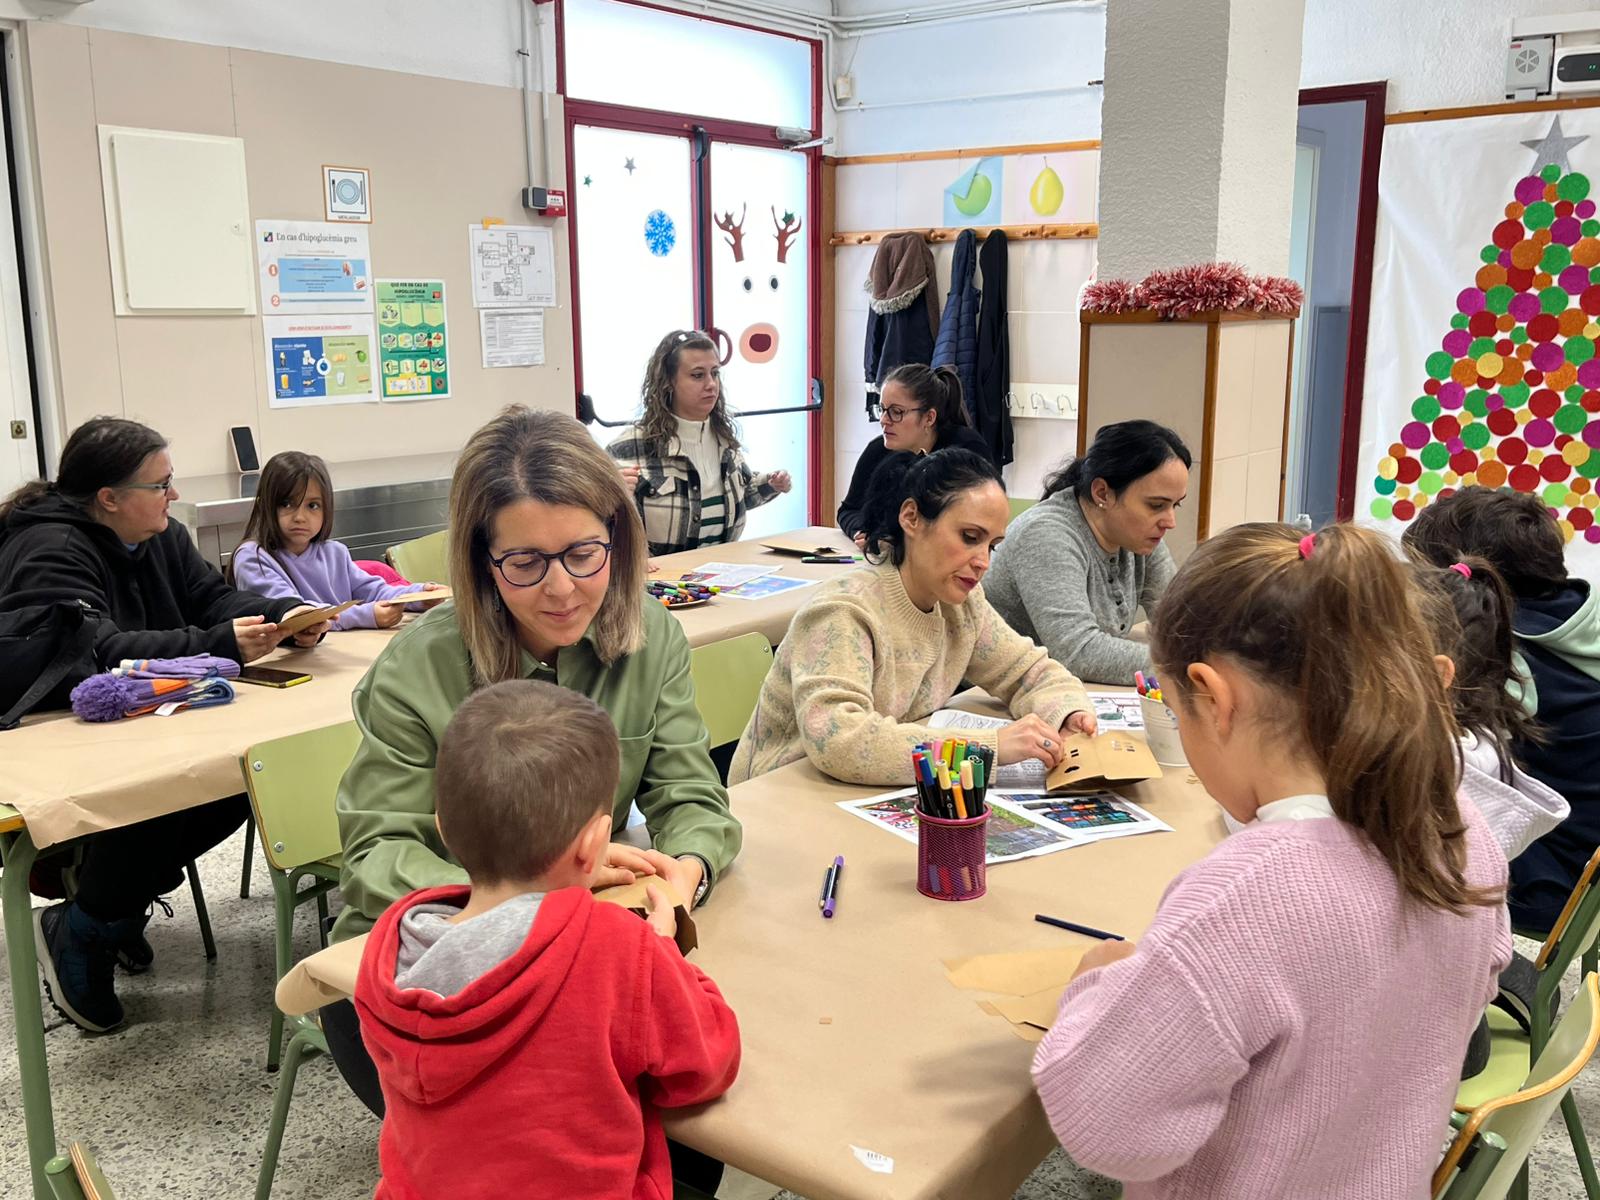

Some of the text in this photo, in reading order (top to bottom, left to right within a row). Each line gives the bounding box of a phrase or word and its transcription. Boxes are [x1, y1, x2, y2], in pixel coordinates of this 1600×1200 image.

[276, 232, 285, 241] En
[286, 233, 297, 241] cas
[344, 236, 357, 244] greu
